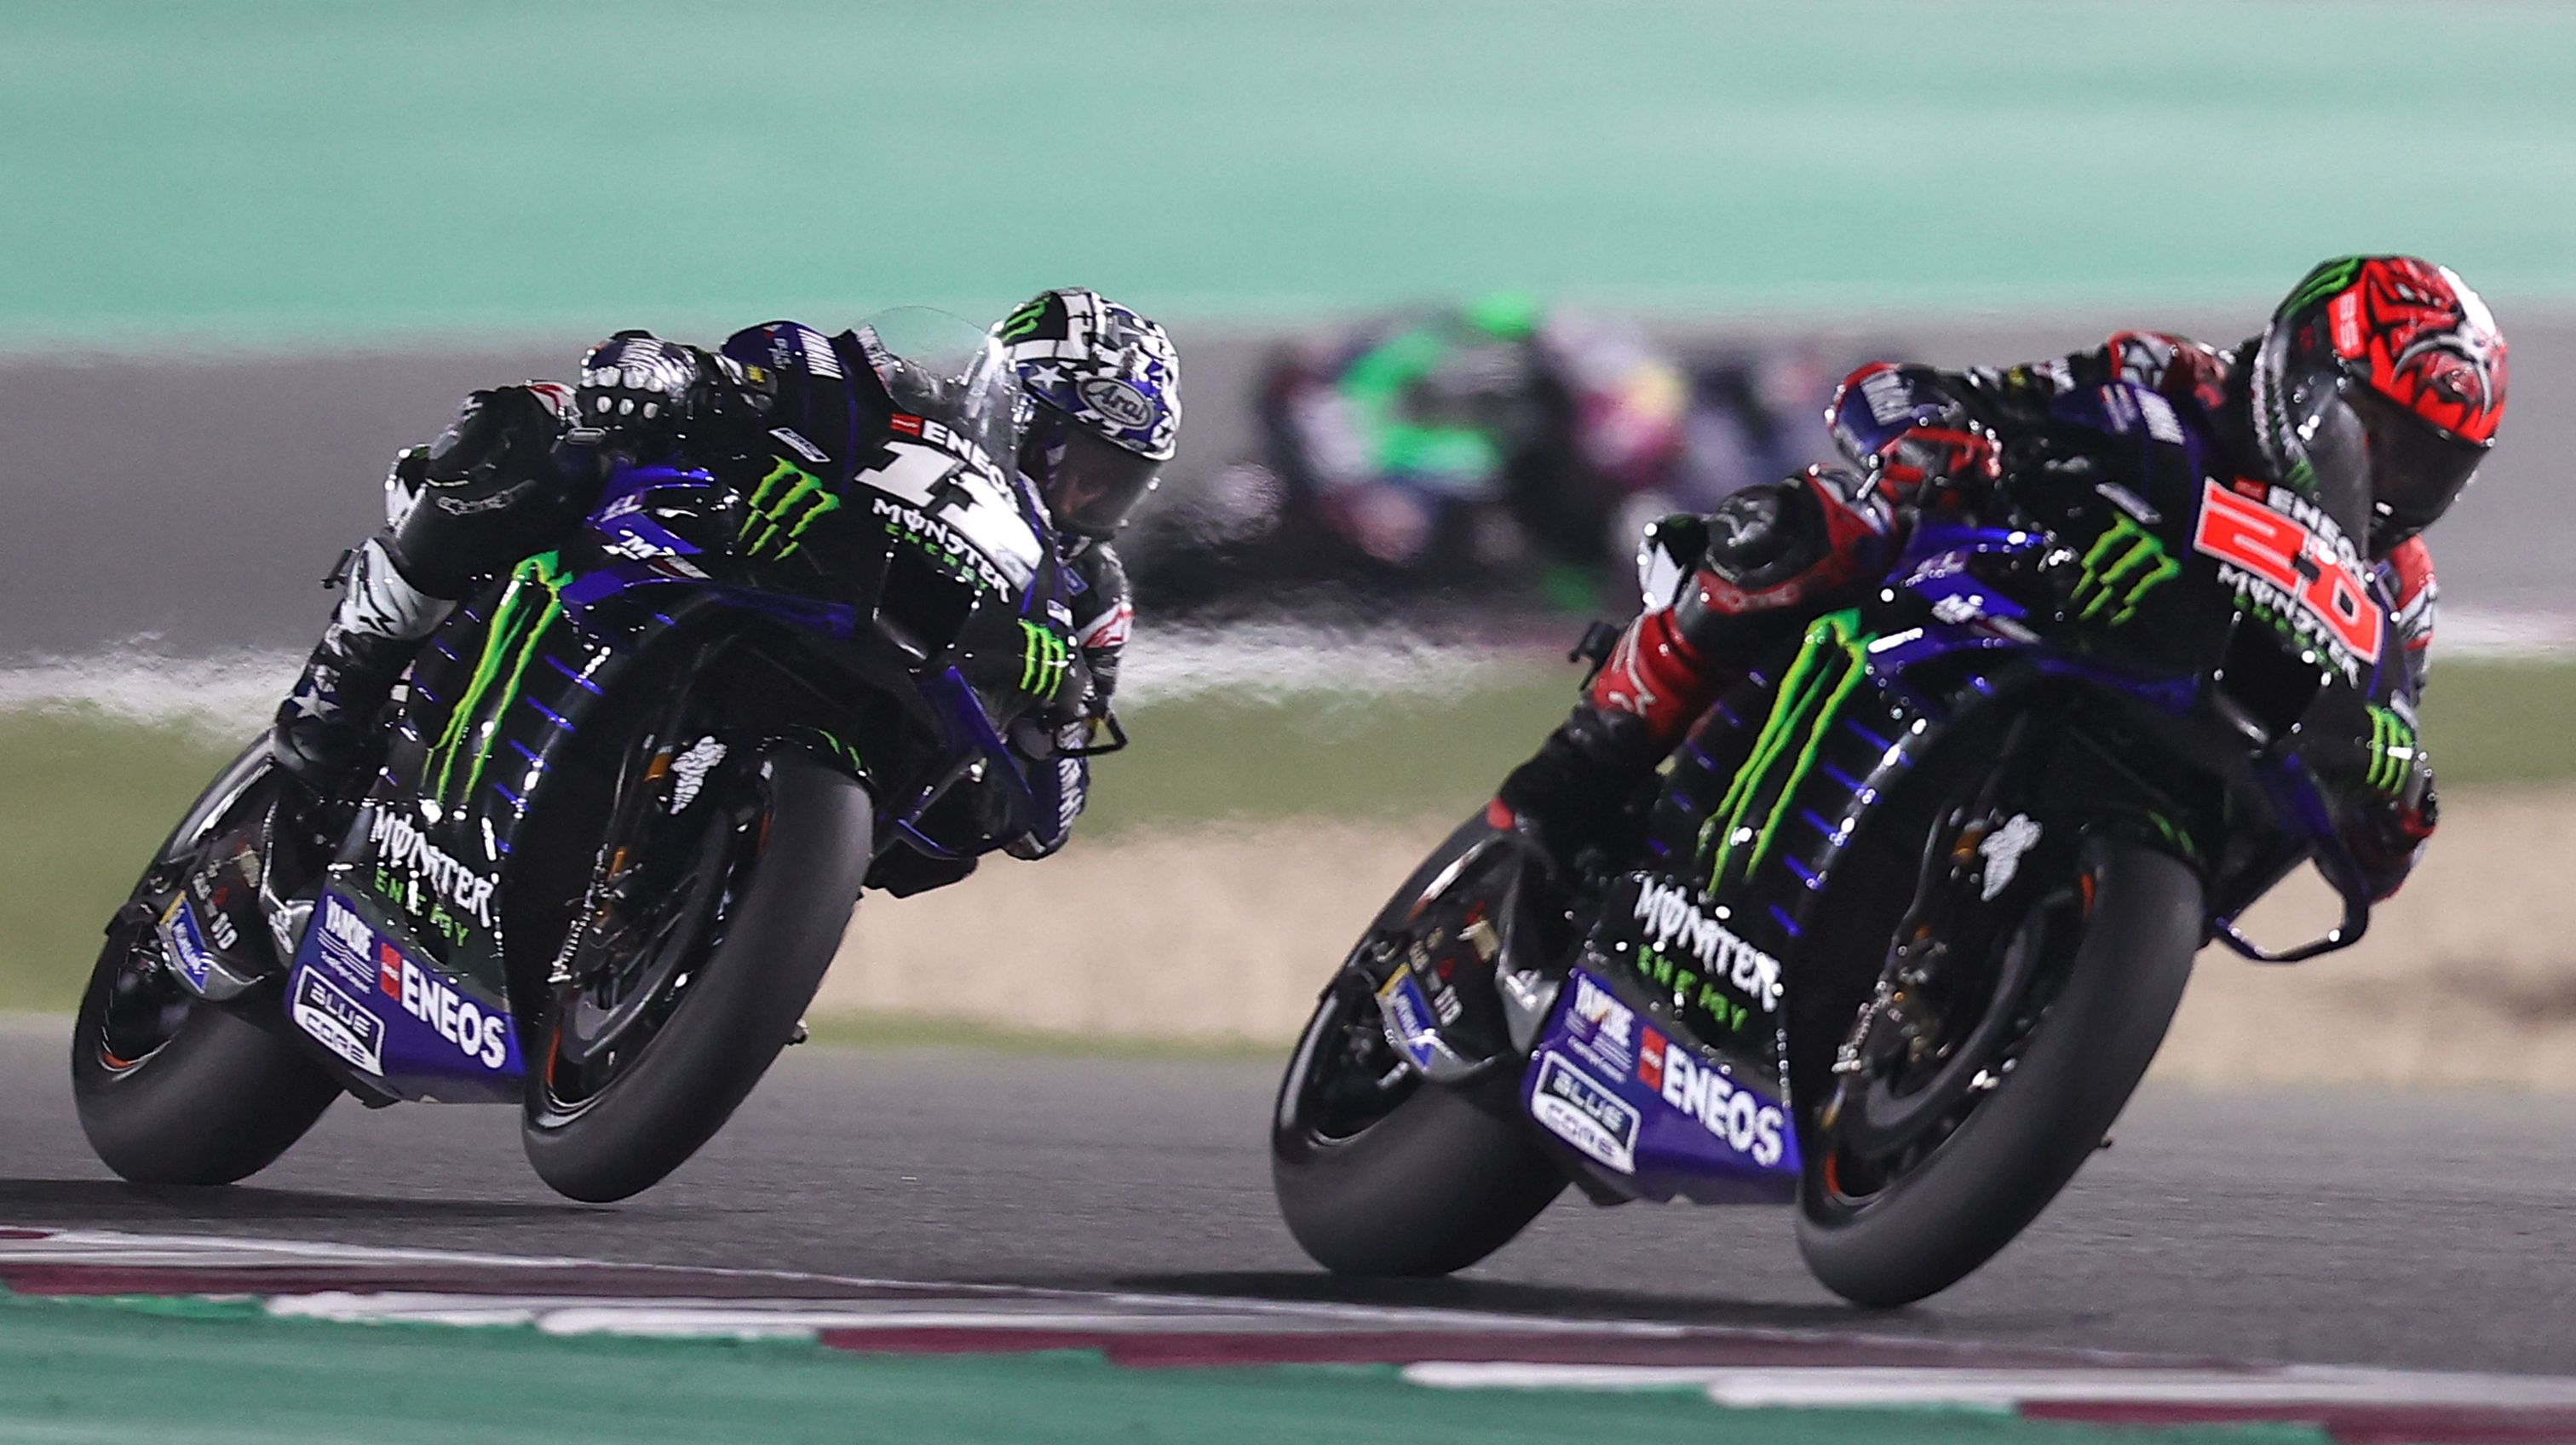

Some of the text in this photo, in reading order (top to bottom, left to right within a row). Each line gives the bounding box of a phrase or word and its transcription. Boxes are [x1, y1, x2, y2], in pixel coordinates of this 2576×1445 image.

[872, 498, 1010, 603] MONSTER
[2193, 475, 2383, 665] 20
[370, 805, 494, 928] MONSTER
[306, 1011, 365, 1064] CORE
[309, 982, 371, 1038] BLUE
[401, 959, 507, 1068] ENEOS
[1662, 1044, 1784, 1166] ENEOS
